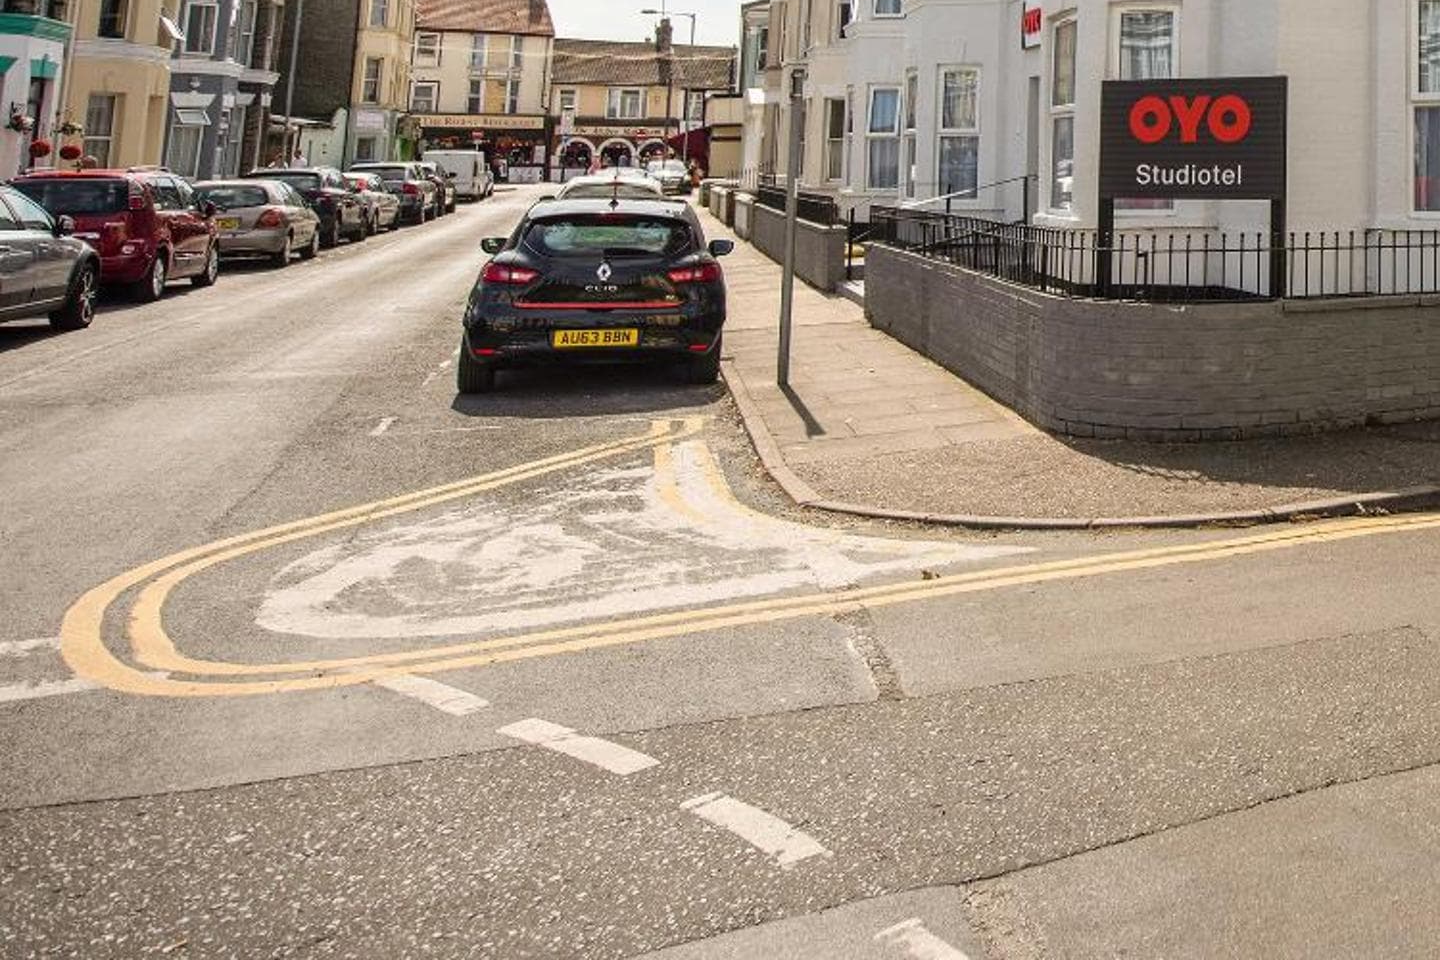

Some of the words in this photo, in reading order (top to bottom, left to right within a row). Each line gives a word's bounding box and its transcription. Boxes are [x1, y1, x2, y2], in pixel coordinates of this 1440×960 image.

[1129, 94, 1252, 144] OYO
[1136, 164, 1242, 185] Studiotel
[585, 284, 618, 293] CLIO
